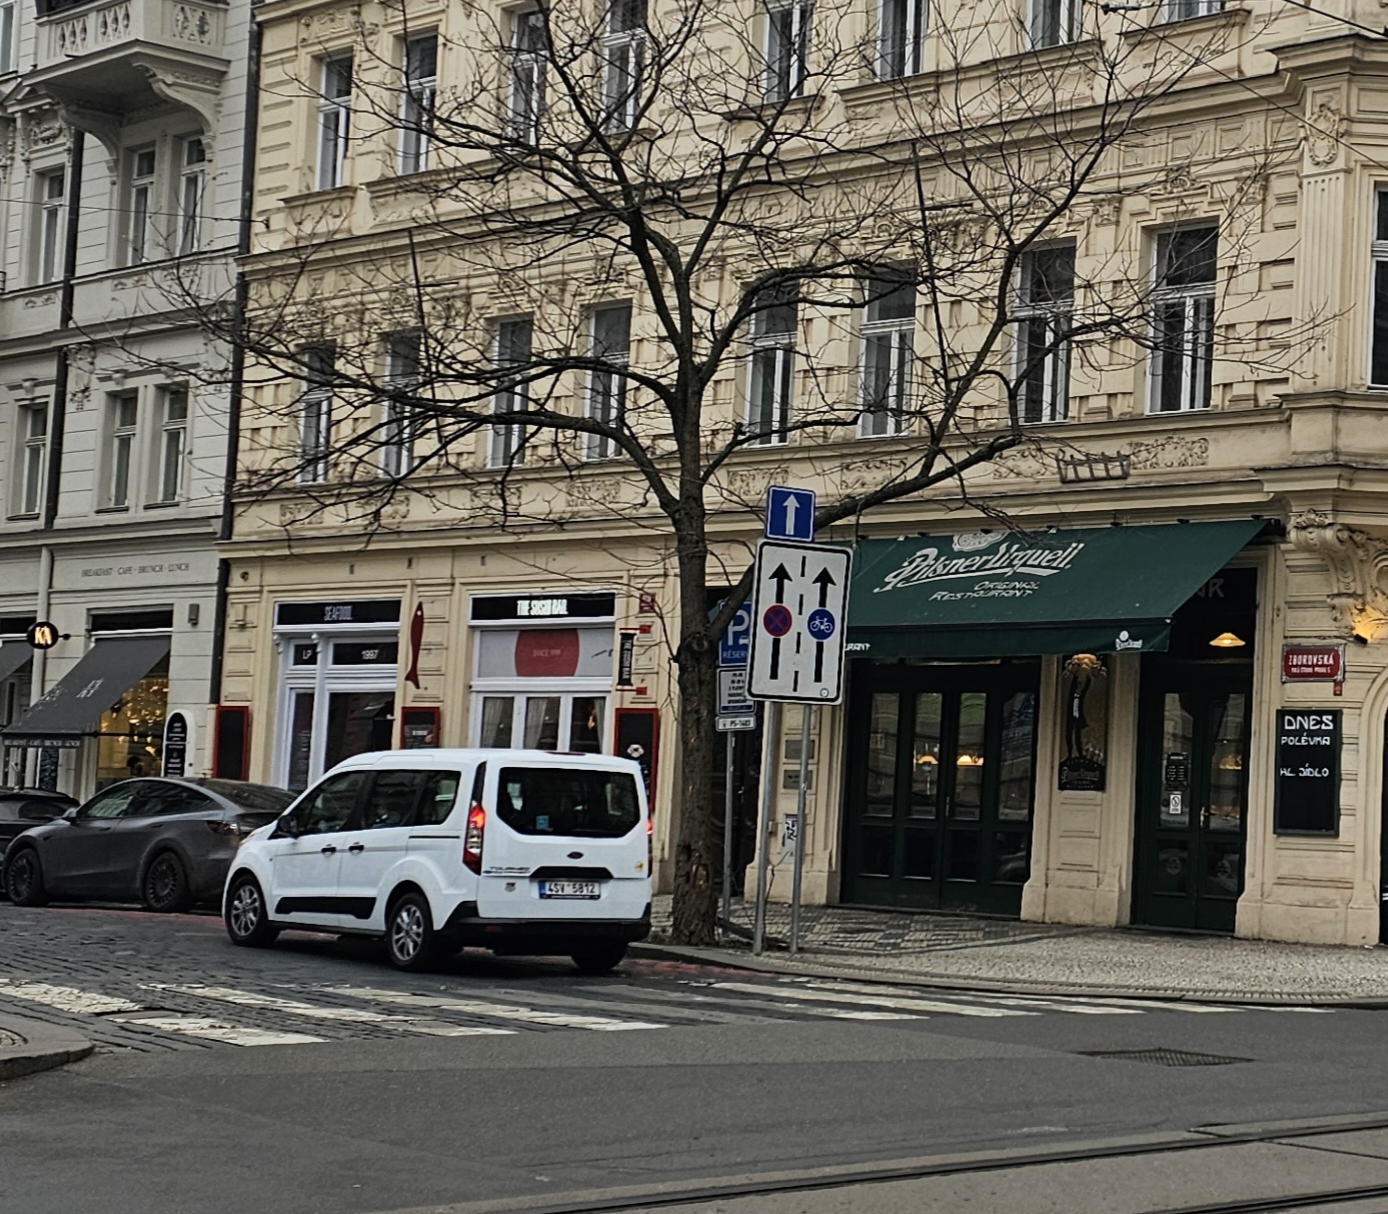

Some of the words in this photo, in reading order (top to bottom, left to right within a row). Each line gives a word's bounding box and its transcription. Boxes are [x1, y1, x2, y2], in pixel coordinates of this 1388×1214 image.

[928, 590, 1033, 602] RESTAURANT
[1288, 653, 1334, 666] ZBOROVSKÁ
[1284, 715, 1334, 730] DNES
[1280, 732, 1330, 746] POLÉVKA
[1299, 763, 1330, 778] JÍDLO
[548, 881, 565, 894] 4SV
[572, 881, 596, 894] 5812
